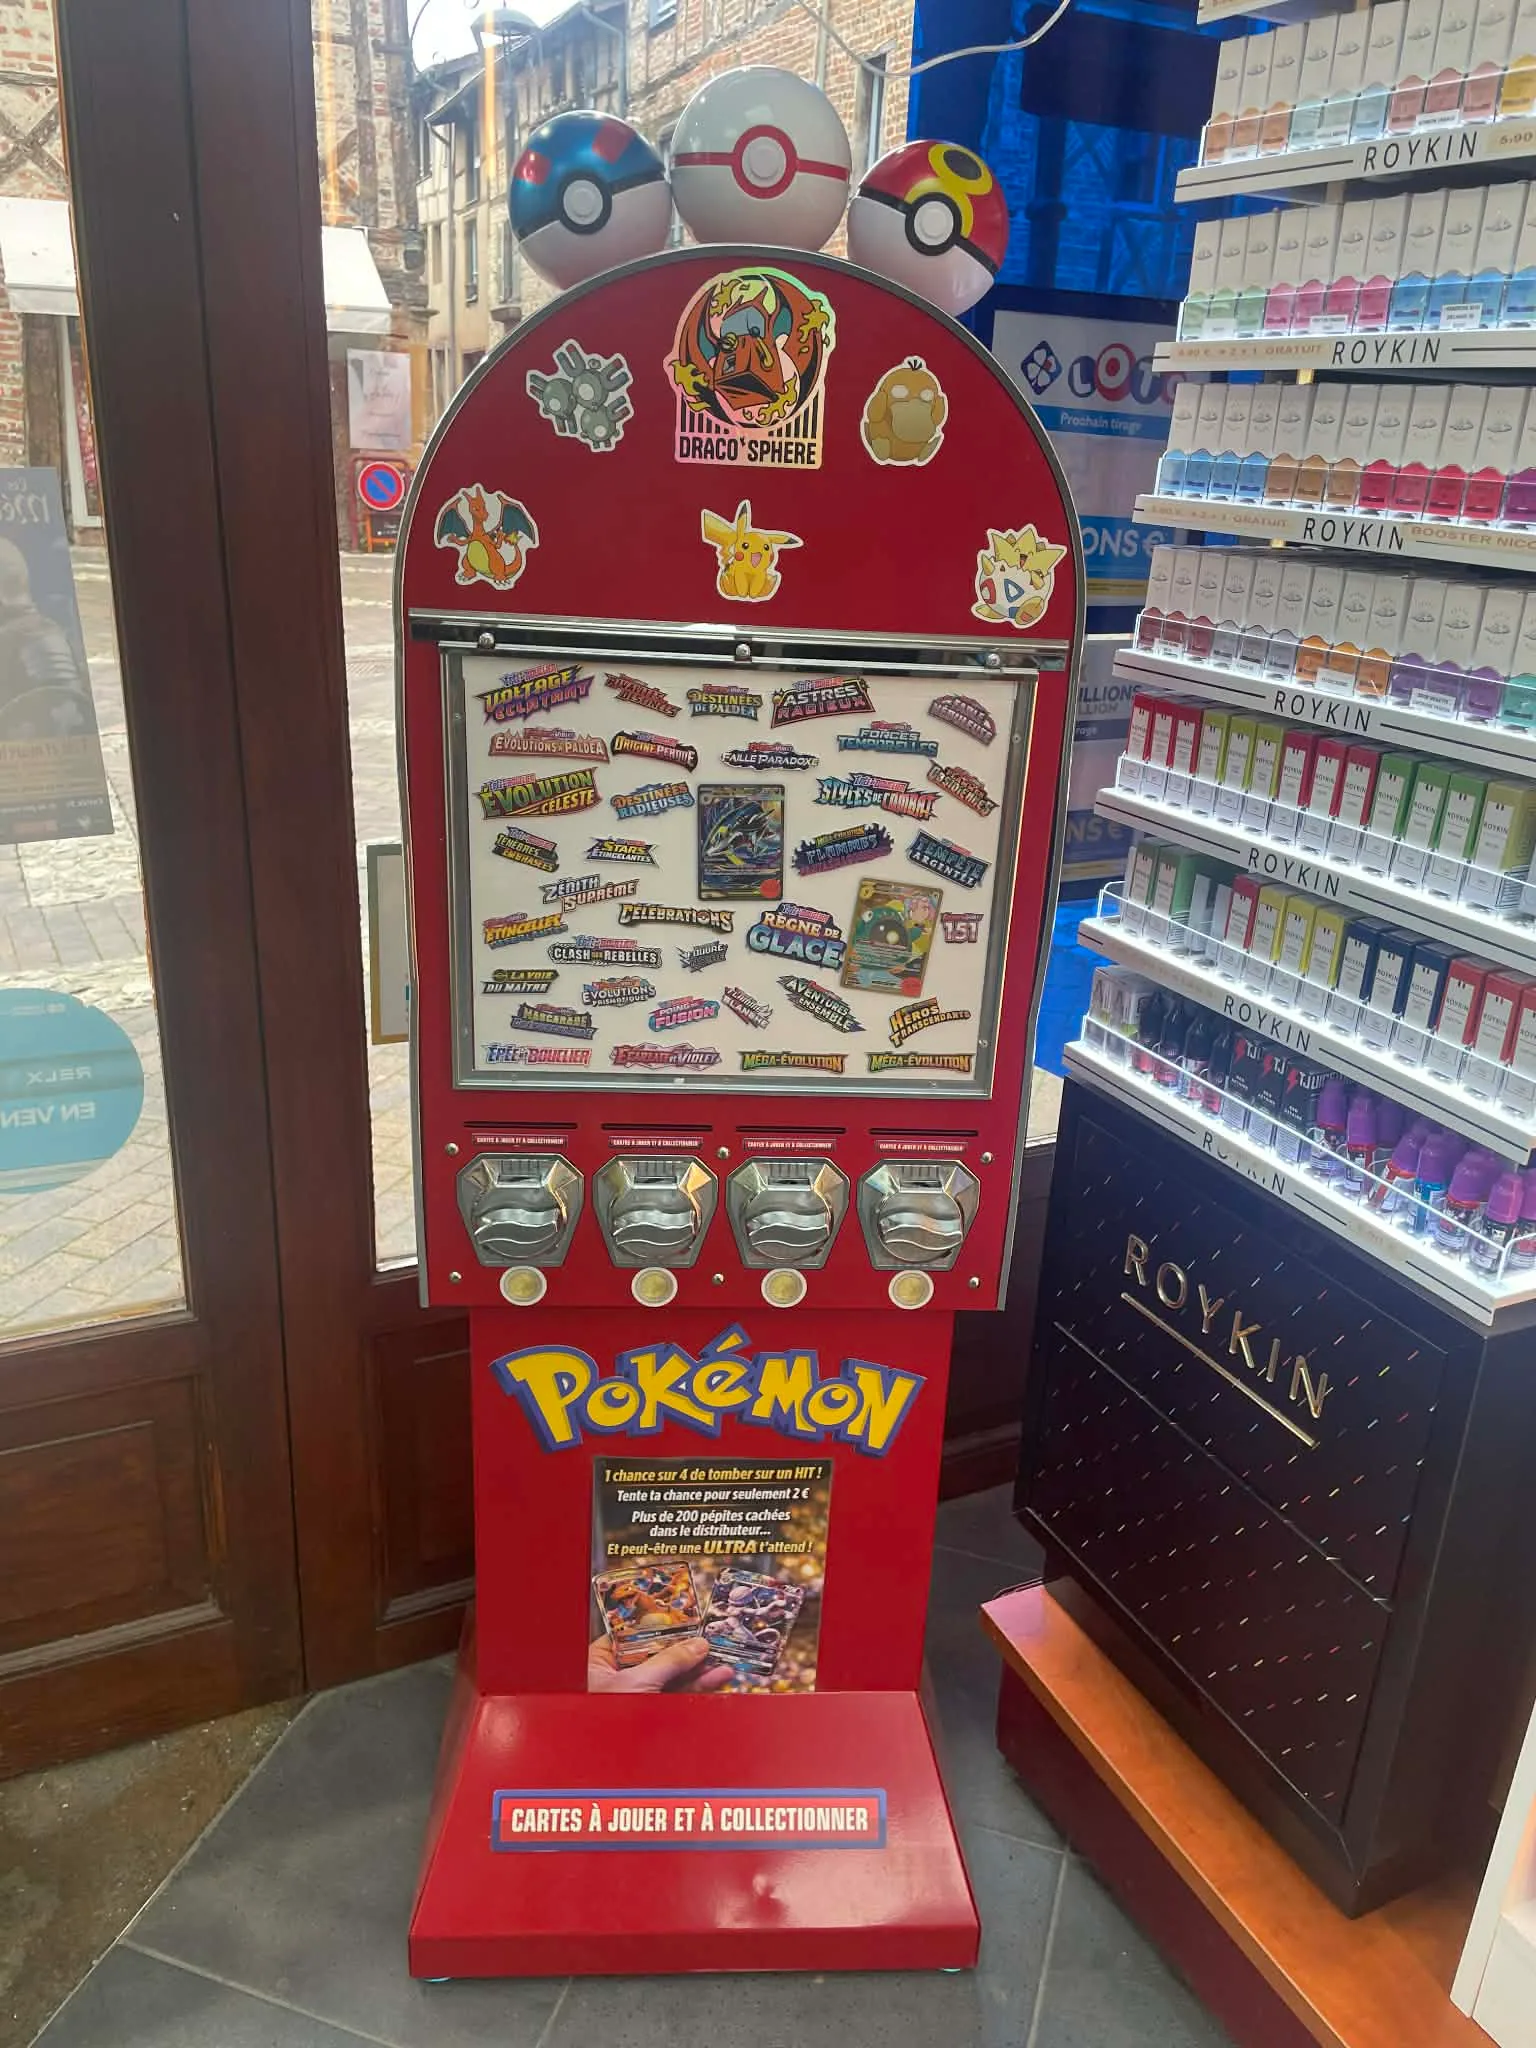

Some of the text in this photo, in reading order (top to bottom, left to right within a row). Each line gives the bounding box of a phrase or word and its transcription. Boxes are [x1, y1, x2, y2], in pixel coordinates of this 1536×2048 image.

[1364, 131, 1478, 171] ROYKIN
[1332, 337, 1441, 365] ROYKIN
[1060, 411, 1108, 430] Prochain
[1303, 517, 1405, 551] ROYKIN
[1411, 526, 1492, 545] BOOSTER
[485, 669, 572, 712] VOLTAGE
[783, 685, 859, 707] ASTRES
[709, 704, 757, 718] PALDEA
[1274, 690, 1372, 733] ROYKIN
[860, 729, 919, 741] FORCES
[565, 742, 605, 755] PALDEA
[614, 735, 657, 753] ORIGINE
[721, 753, 819, 767] FAILLE PARADOXE
[1284, 765, 1302, 776] ROYKIN
[1316, 774, 1335, 785] ROYKIN
[1345, 783, 1367, 794] ROYKIN
[1378, 791, 1399, 803] ROYKIN
[617, 794, 693, 819] RADIEUSES
[1414, 801, 1436, 814] ROYKIN
[1448, 811, 1471, 824] ROYKIN
[1484, 822, 1508, 834] ROYKIN
[601, 841, 646, 856] STARS
[1247, 846, 1341, 898] ROYKIN
[824, 928, 841, 940] DE
[944, 921, 979, 944] 151
[748, 924, 844, 970] GLACE
[554, 947, 657, 964] CLASH REBELLES
[511, 971, 525, 979] LA
[1378, 968, 1399, 982] ROYKIN
[487, 982, 502, 992] DU
[1411, 983, 1433, 997] ROYKIN
[786, 978, 851, 1016] AVENTURES
[1446, 998, 1469, 1011] ROYKIN
[659, 1004, 686, 1016] POING
[798, 997, 854, 1031] ENSEMBLE
[655, 1007, 716, 1030] FUSION
[1224, 995, 1311, 1052] ROYKIN
[1483, 1013, 1507, 1026] ROYKIN
[529, 1047, 592, 1065] BOUCLIER
[679, 1046, 720, 1065] VIOLET
[1124, 1233, 1329, 1418] ROYKIN
[606, 1467, 822, 1481] 1 chance sur 4 de tomber sur un HIT !
[618, 1488, 809, 1502] Tente ta chance pour seulement 2 €
[631, 1508, 791, 1524] Plus de 200 pépites cachées
[649, 1524, 771, 1537] dans le distributeur...
[607, 1540, 813, 1556] Et peut-être une ULTRA t'attend !
[511, 1803, 868, 1833] CARTES À JOUER ET À COLLECTIONNER
